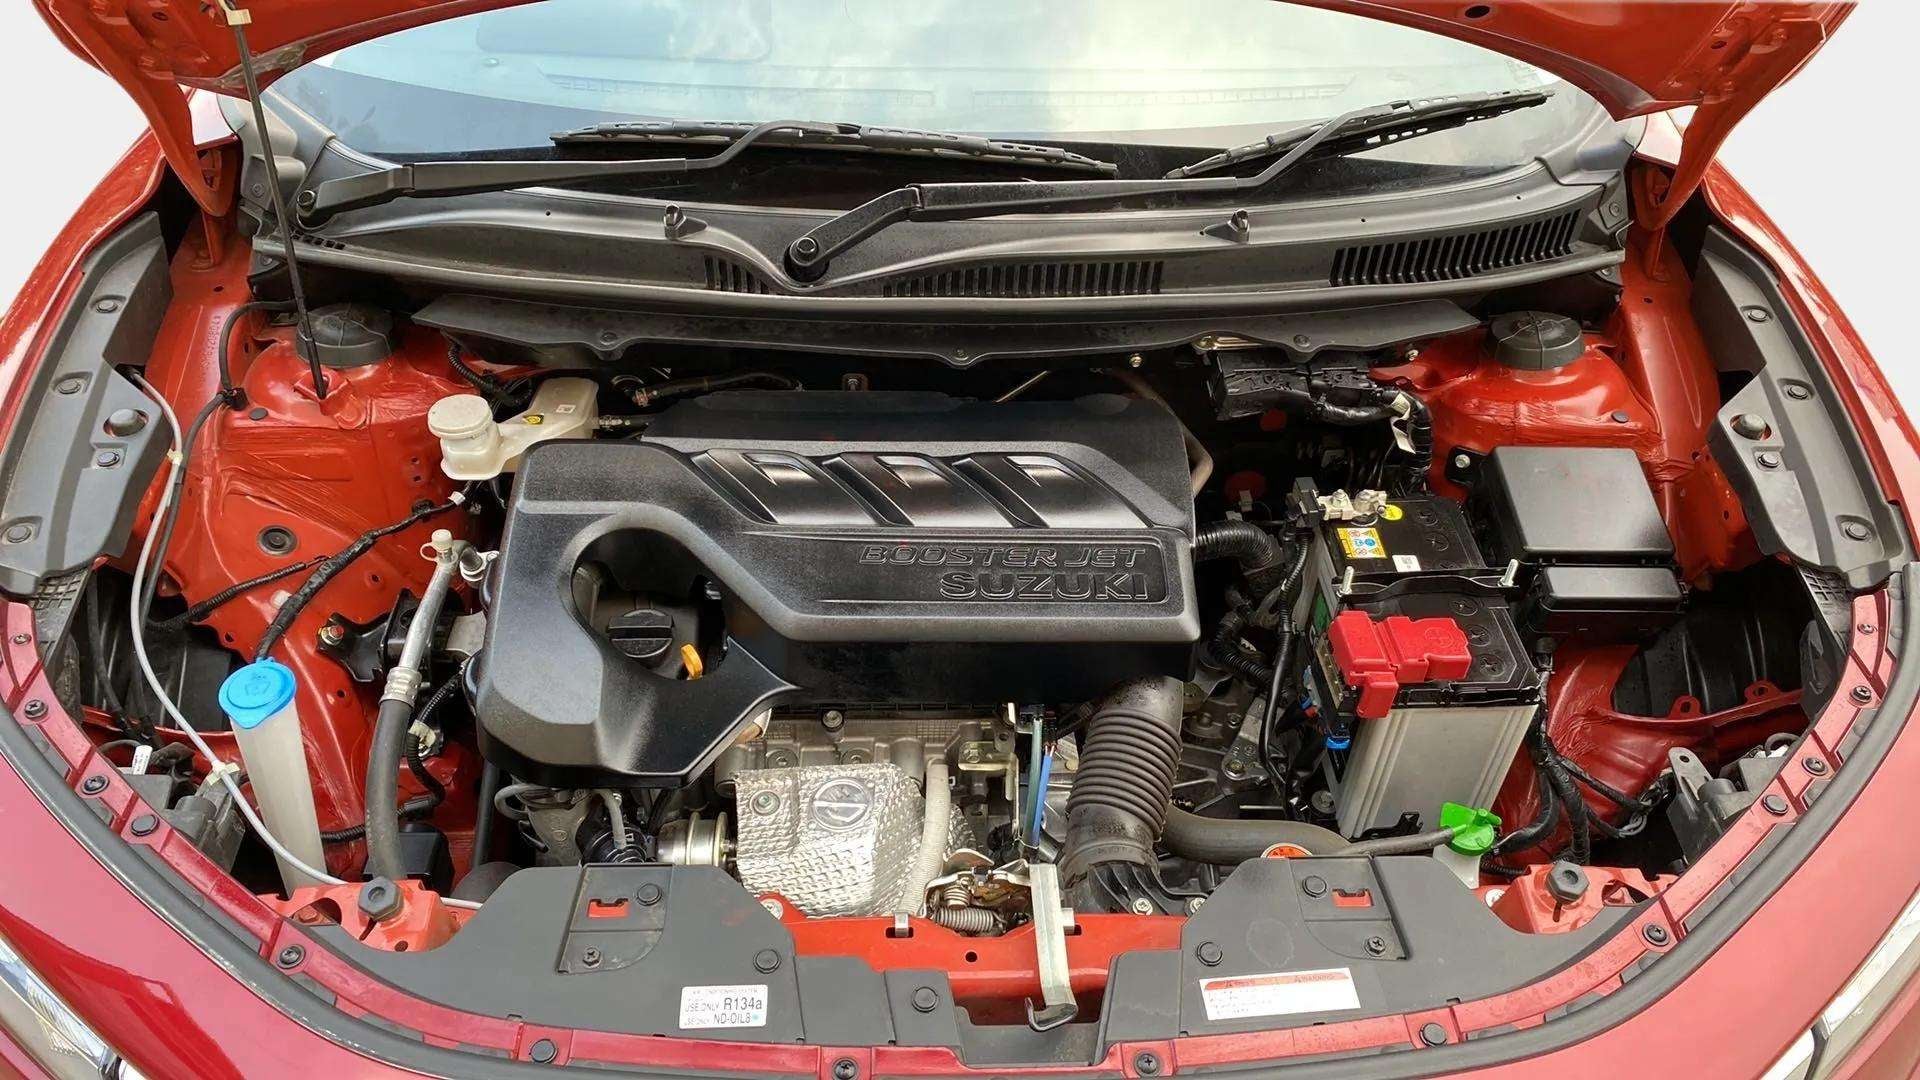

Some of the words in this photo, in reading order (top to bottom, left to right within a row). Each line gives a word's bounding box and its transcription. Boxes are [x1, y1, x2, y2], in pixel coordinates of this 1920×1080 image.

[858, 544, 1058, 568] BOOSTER
[1064, 545, 1146, 568] JET
[939, 571, 1150, 600] SUZUKI
[723, 996, 763, 1011] R134a
[713, 1012, 751, 1025] ND-OIL8
